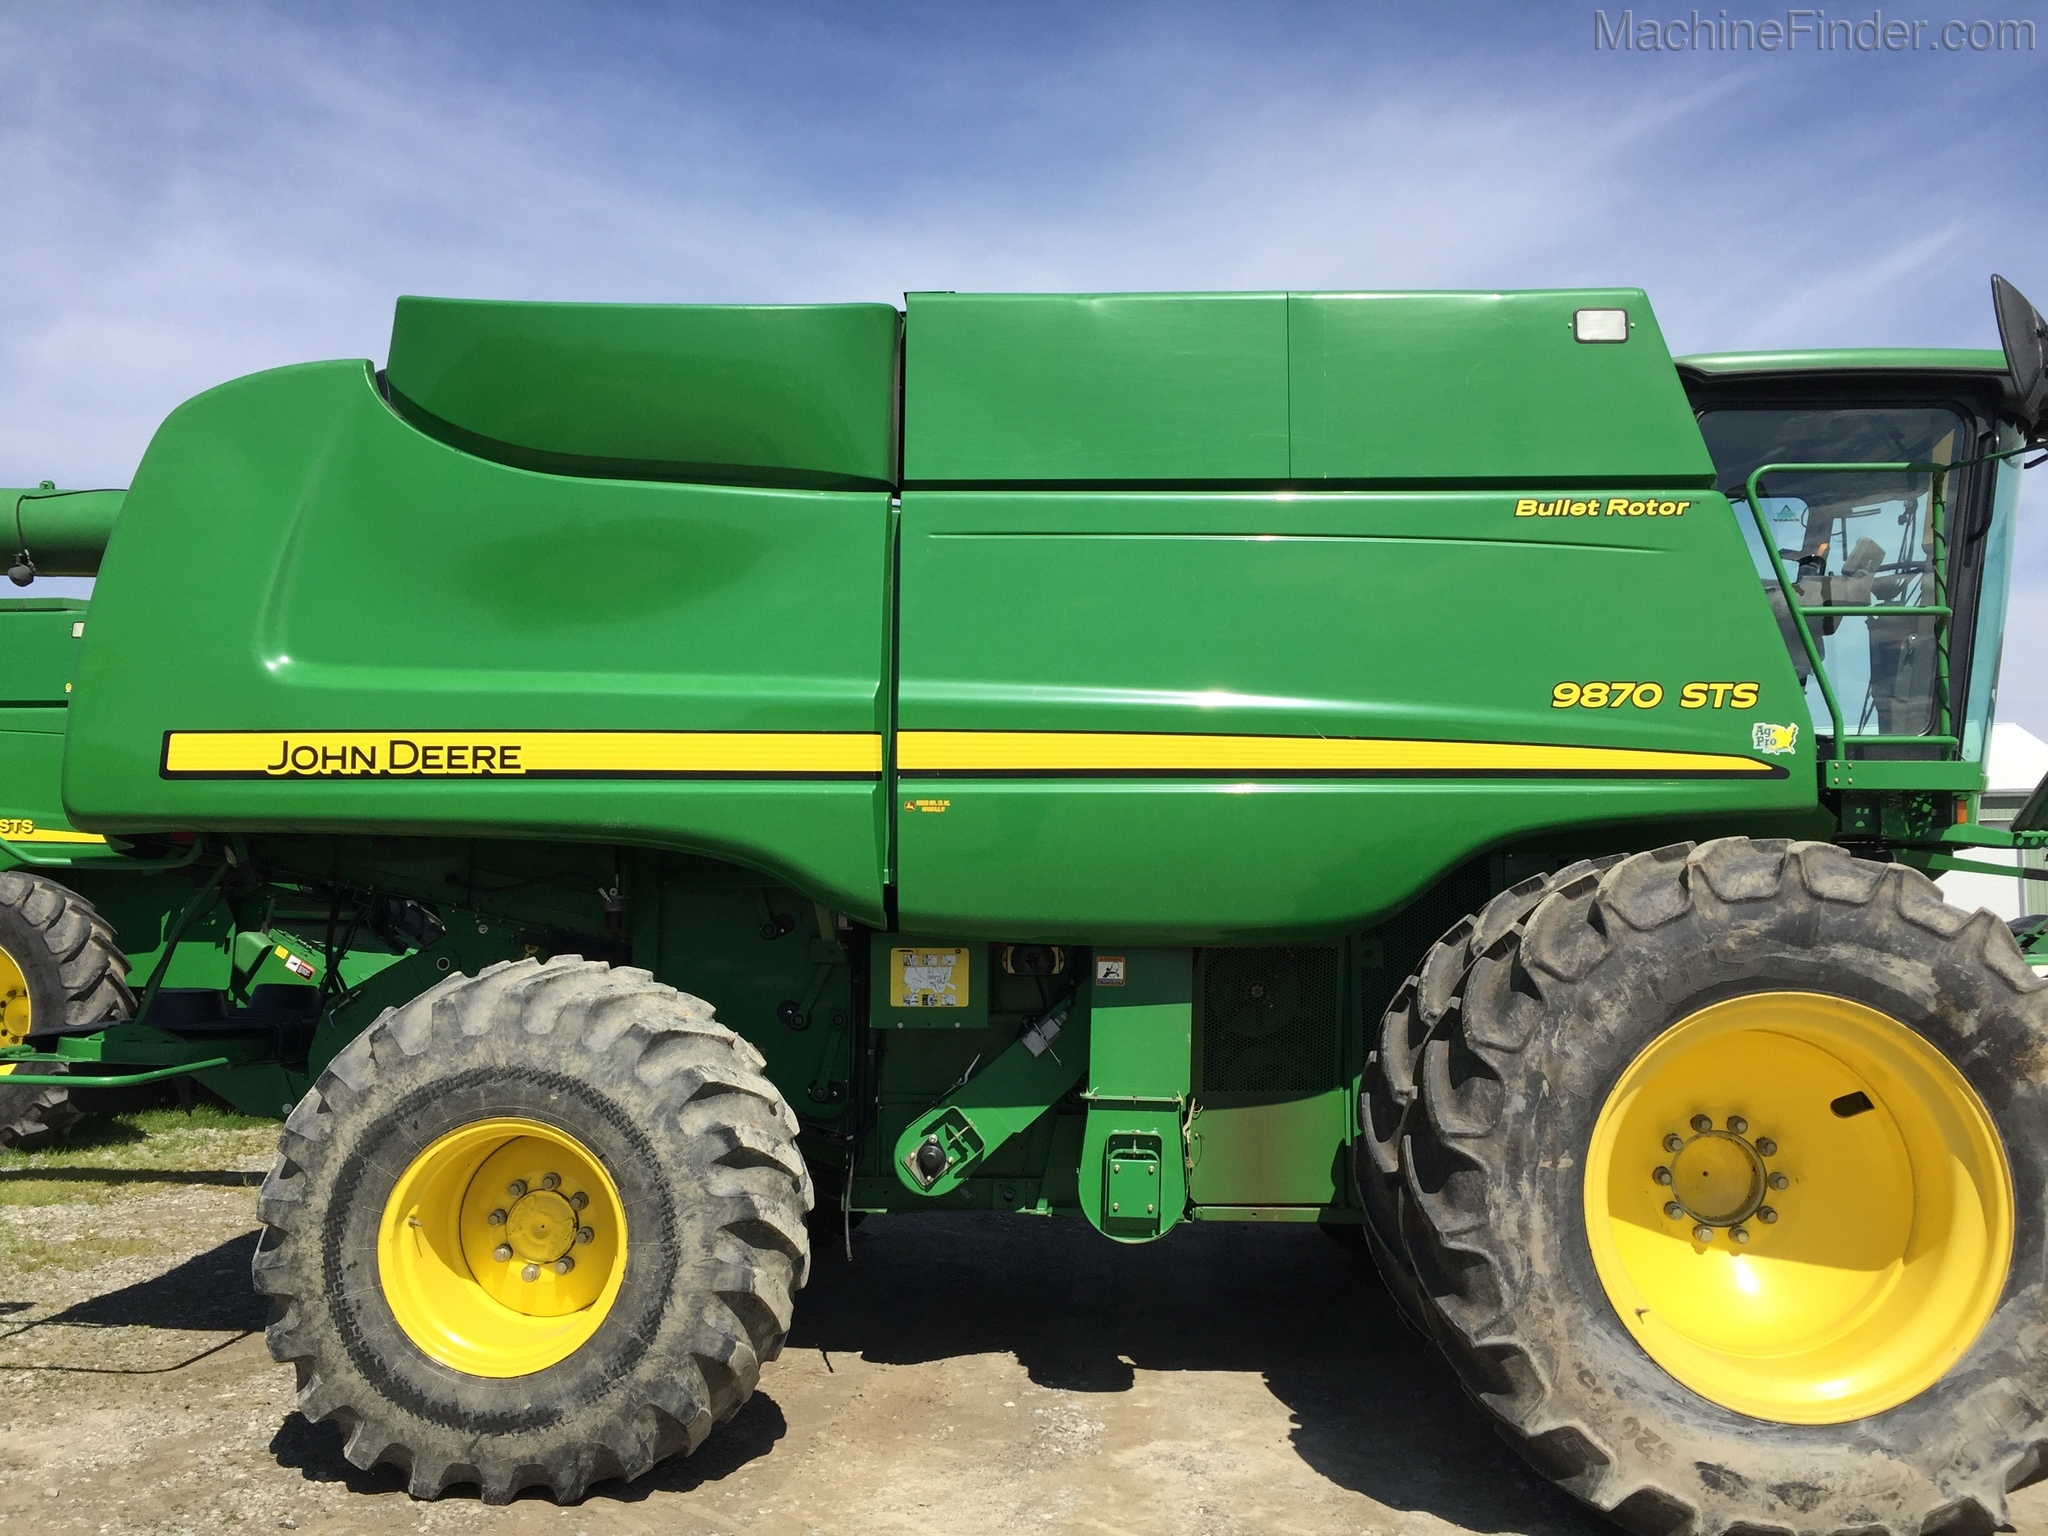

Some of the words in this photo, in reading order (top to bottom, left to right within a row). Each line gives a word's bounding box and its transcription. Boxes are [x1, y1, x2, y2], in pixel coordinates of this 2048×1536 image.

[1514, 498, 1601, 517] Bullet
[1605, 498, 1691, 517] Rotor
[1551, 681, 1664, 709] 9870
[1679, 681, 1760, 709] STS
[1756, 736, 1777, 747] Pro
[268, 740, 377, 770] JOHN
[389, 740, 522, 770] DEERE
[0, 818, 34, 834] STS
